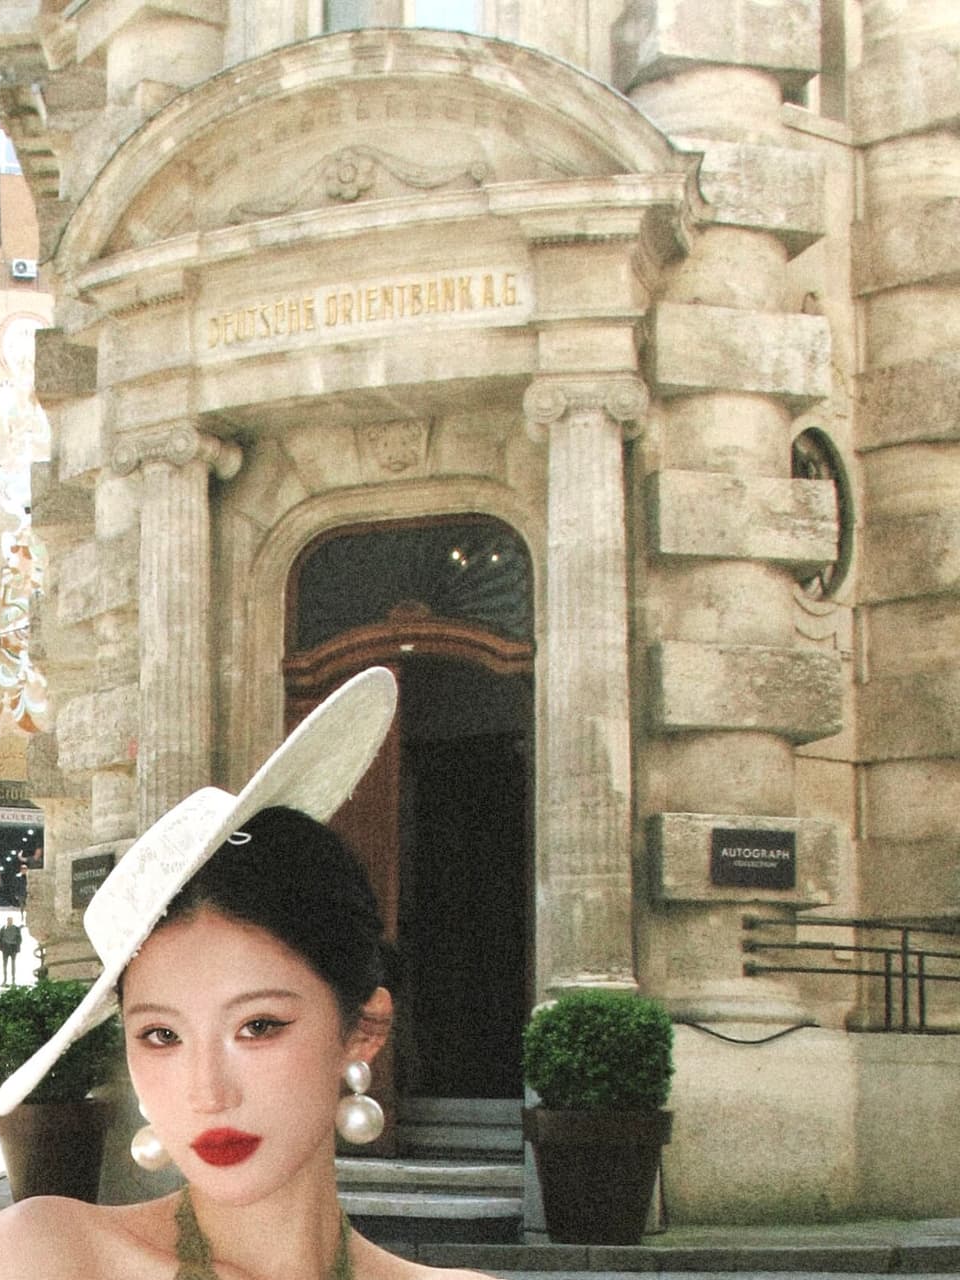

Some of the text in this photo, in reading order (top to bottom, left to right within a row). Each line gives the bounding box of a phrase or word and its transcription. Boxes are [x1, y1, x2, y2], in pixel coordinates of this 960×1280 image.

[208, 297, 315, 348] DEUTSCHE
[325, 275, 473, 327] ORIENTBANK
[721, 847, 790, 859] AUTOGRAPH
